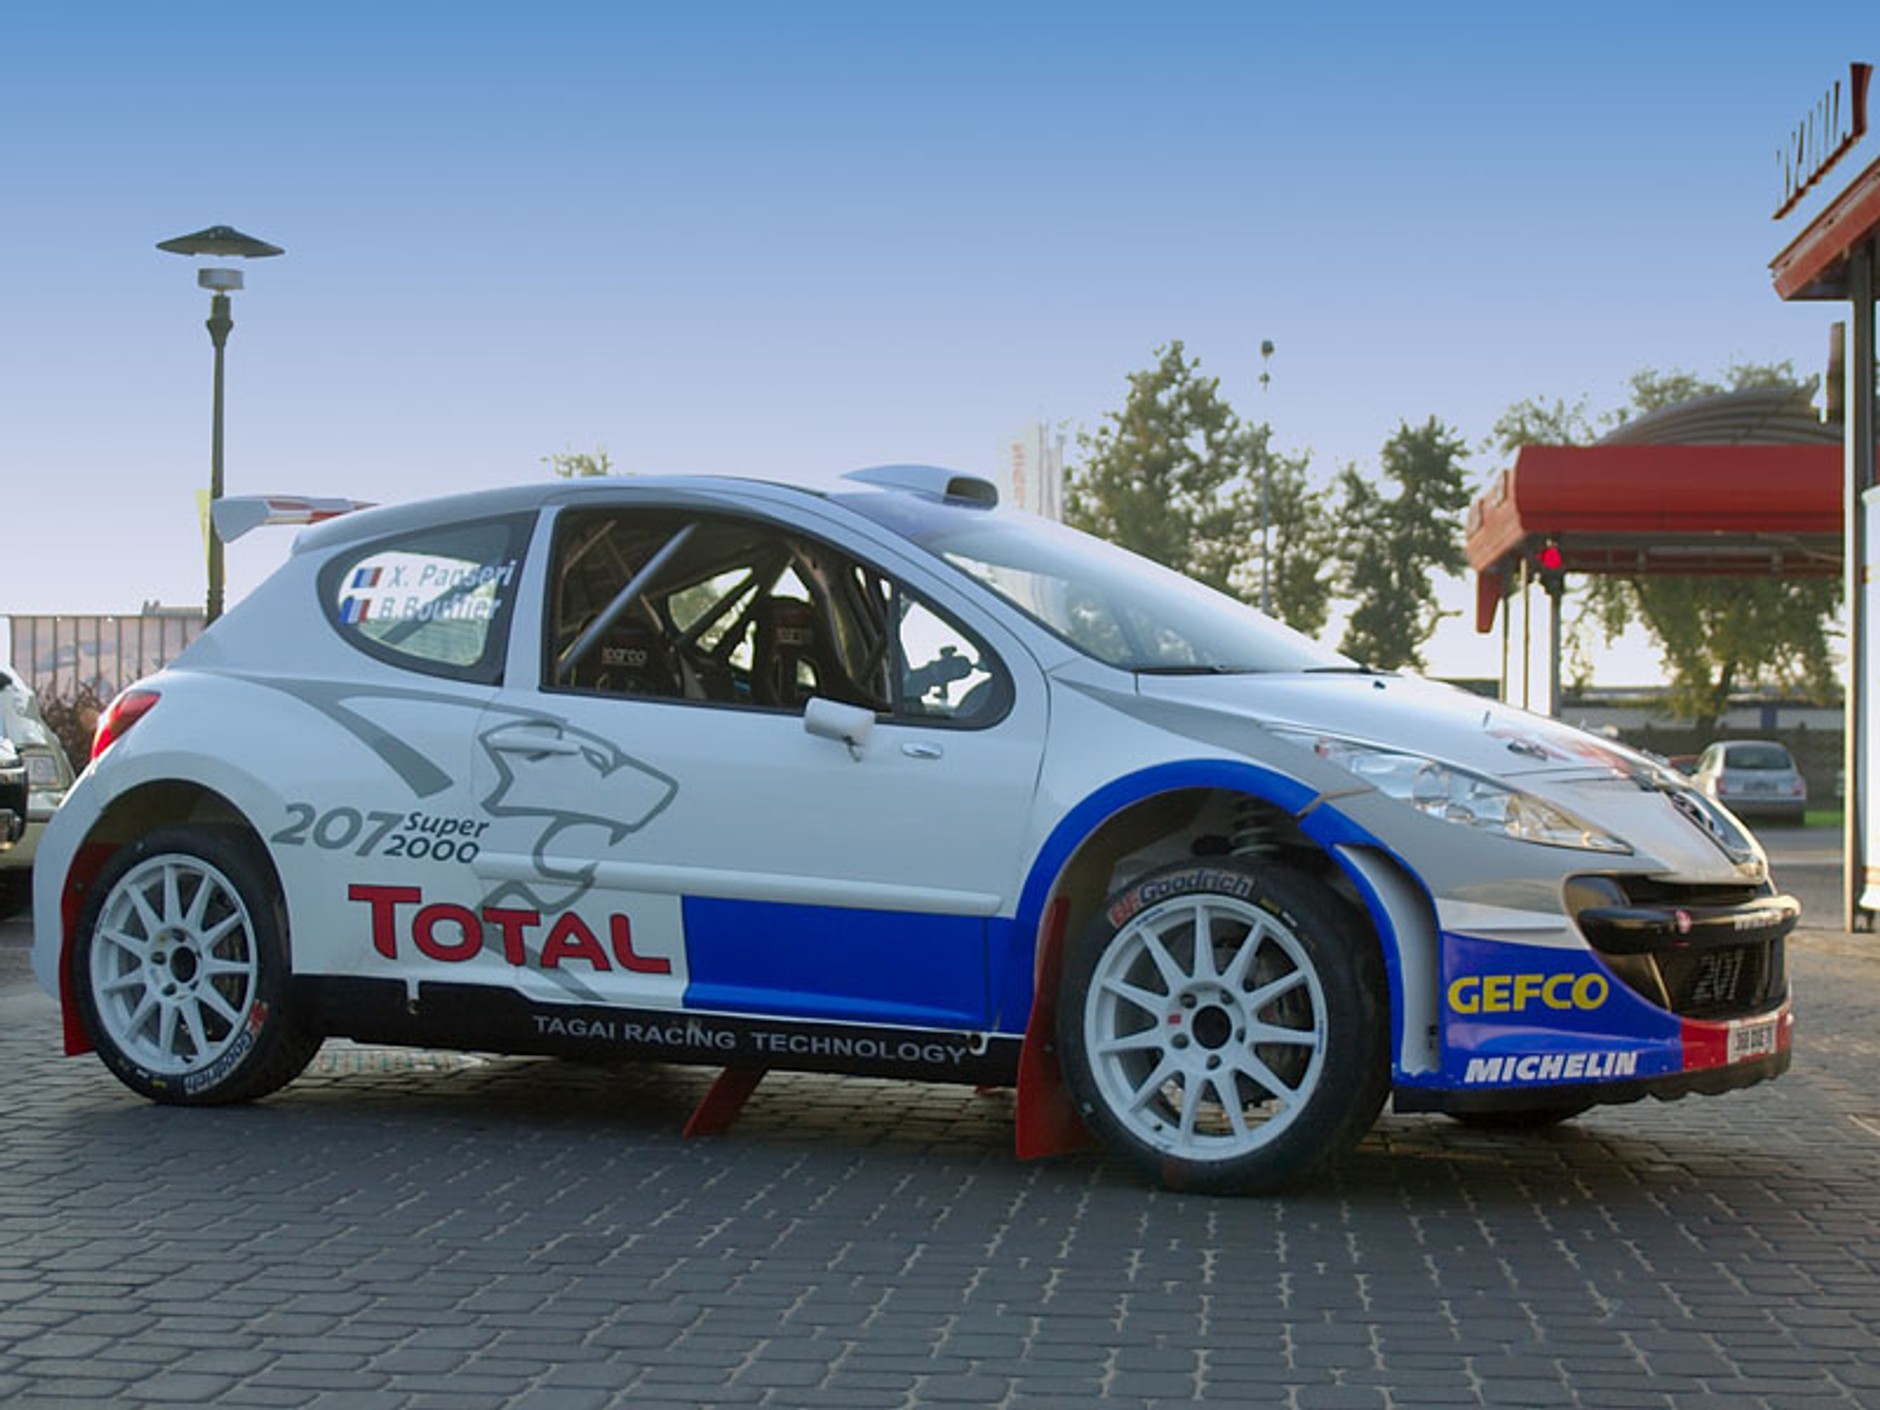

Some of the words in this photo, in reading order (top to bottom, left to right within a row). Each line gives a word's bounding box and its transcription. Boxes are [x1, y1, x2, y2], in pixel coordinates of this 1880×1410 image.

[388, 565, 409, 588] X.
[418, 559, 518, 588] Panseri
[271, 802, 404, 857] 207
[404, 811, 490, 839] Super
[383, 834, 480, 864] 2000
[1448, 972, 1609, 1014] GEFCO
[533, 1014, 615, 1040] TAGAI
[624, 1021, 737, 1050] RACING
[751, 1031, 967, 1065] TECHNOLOGY
[1464, 1050, 1640, 1085] MICHELIN
